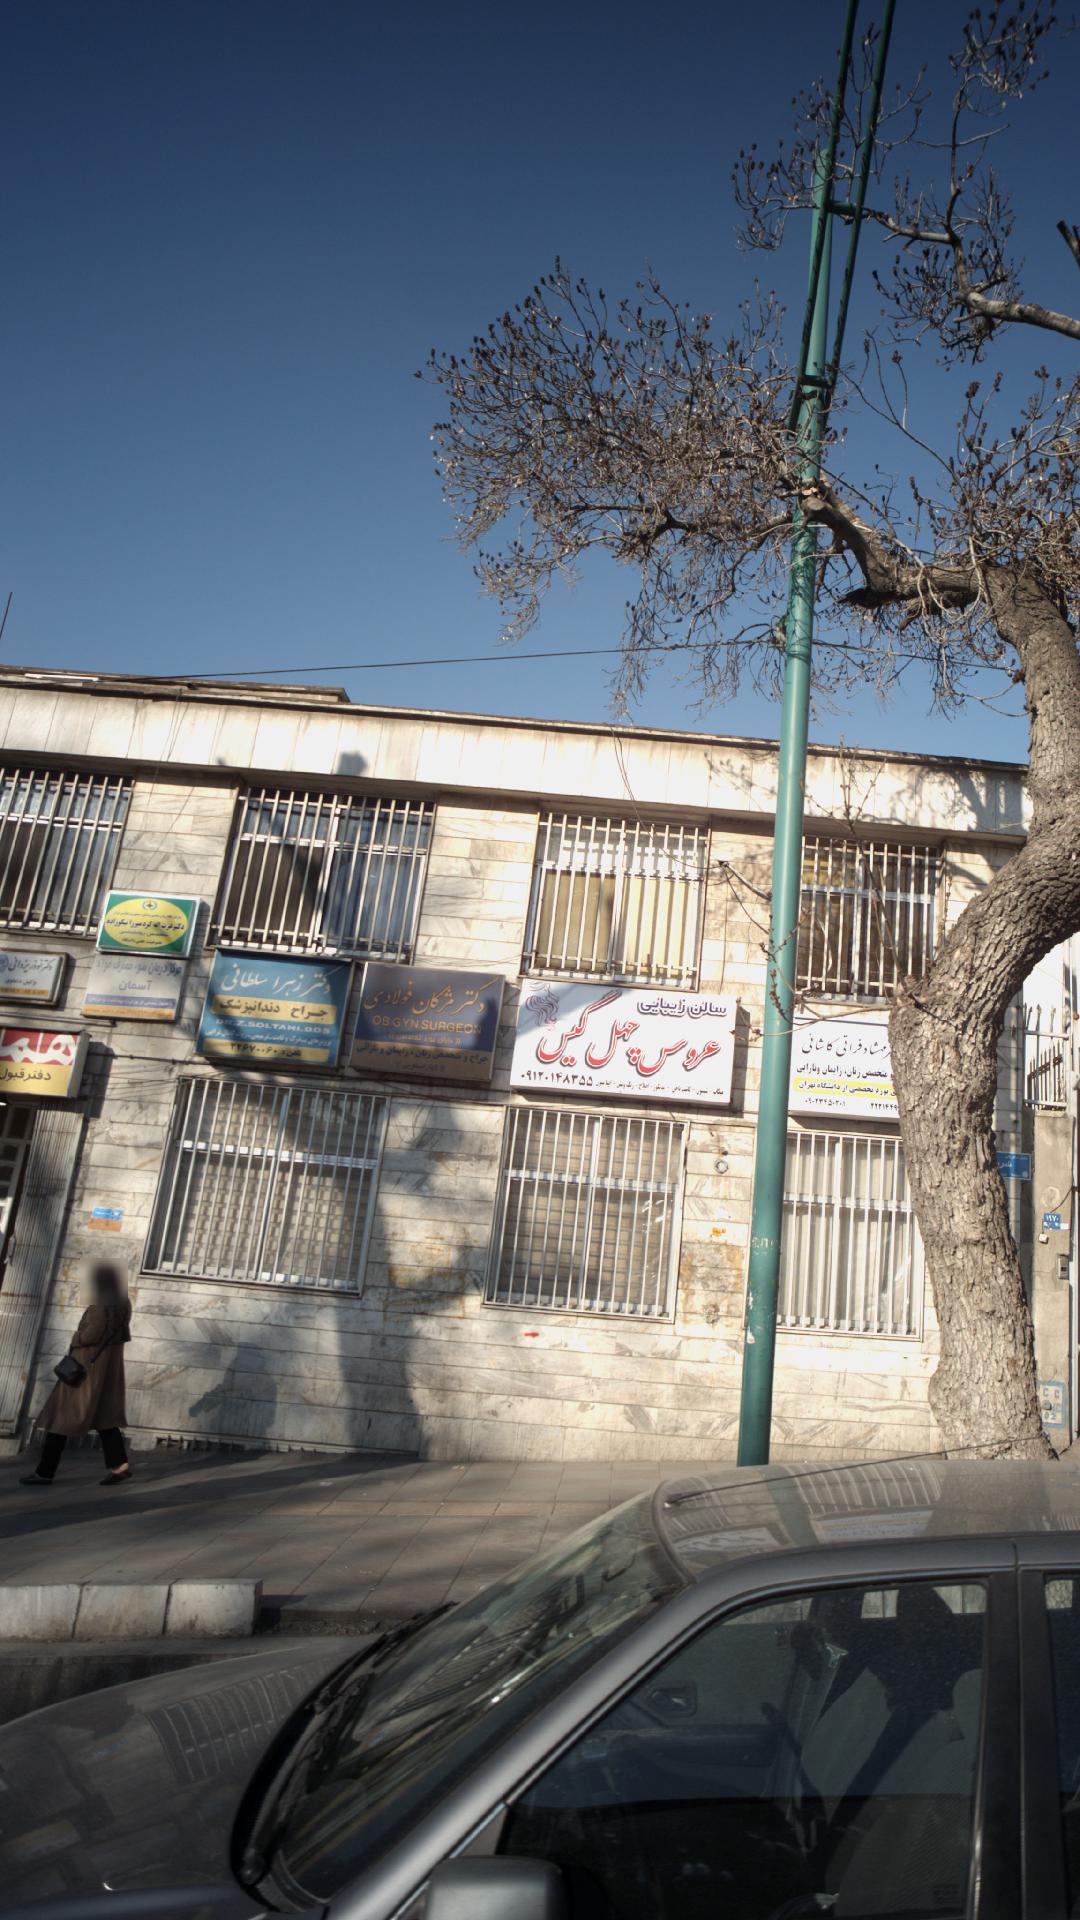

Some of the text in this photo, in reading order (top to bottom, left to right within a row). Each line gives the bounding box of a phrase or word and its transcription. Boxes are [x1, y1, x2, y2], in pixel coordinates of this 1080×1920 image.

[119, 979, 152, 991] آسمان
[221, 963, 267, 991] سلطانی
[219, 1000, 328, 1020] جراح دندانپزشک
[638, 998, 727, 1018] سالن زیبایی
[537, 988, 623, 1066] گیس
[636, 1038, 720, 1077] عروس
[24, 1070, 51, 1081] دفتر
